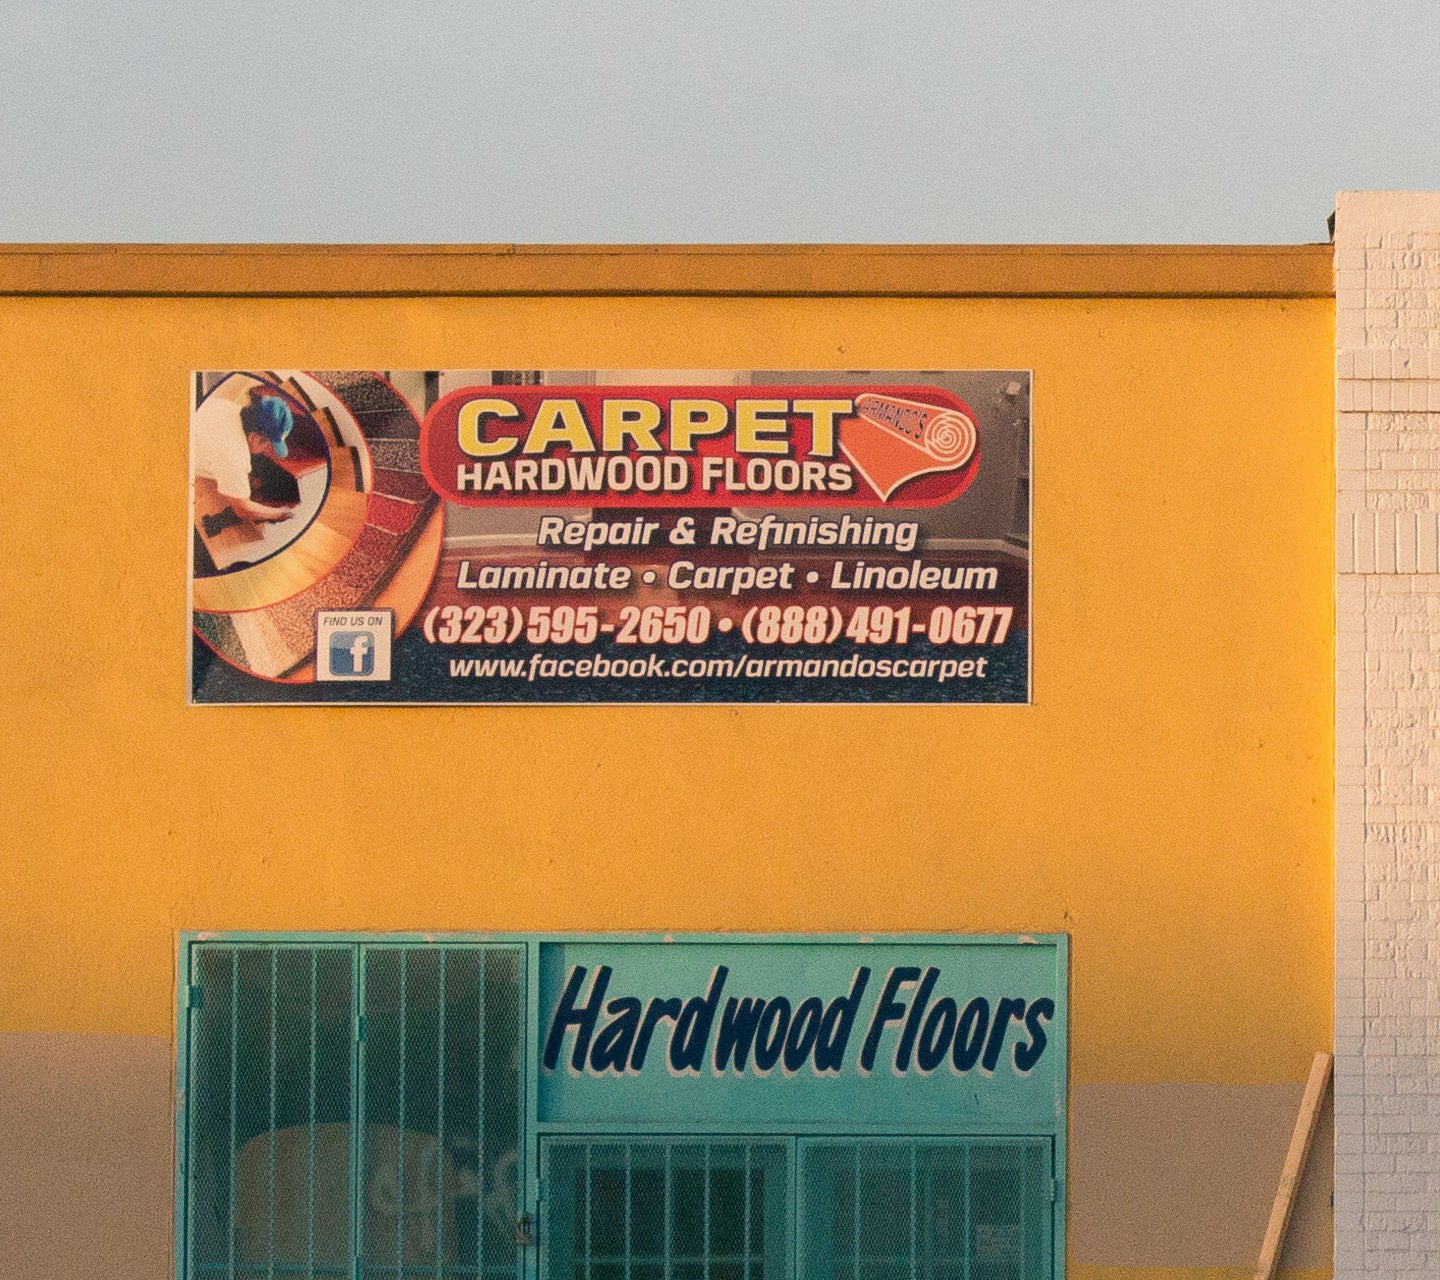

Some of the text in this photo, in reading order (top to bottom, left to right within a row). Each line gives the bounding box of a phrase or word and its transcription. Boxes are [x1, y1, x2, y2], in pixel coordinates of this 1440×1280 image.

[457, 398, 853, 457] CARPET
[861, 399, 928, 440] ARMANDO'S
[457, 455, 853, 492] HARDWOOD FLOORS
[537, 514, 919, 552] Repair & Refinishing
[457, 561, 998, 596] Laminate Carpet Linoleum
[323, 616, 383, 626] FIND US ON
[423, 605, 1013, 645] (323)595-2650 (888)491-0677
[449, 653, 988, 682] www.facebook.com/armandoscarpet
[542, 965, 1055, 1077] Hardwood Floors
